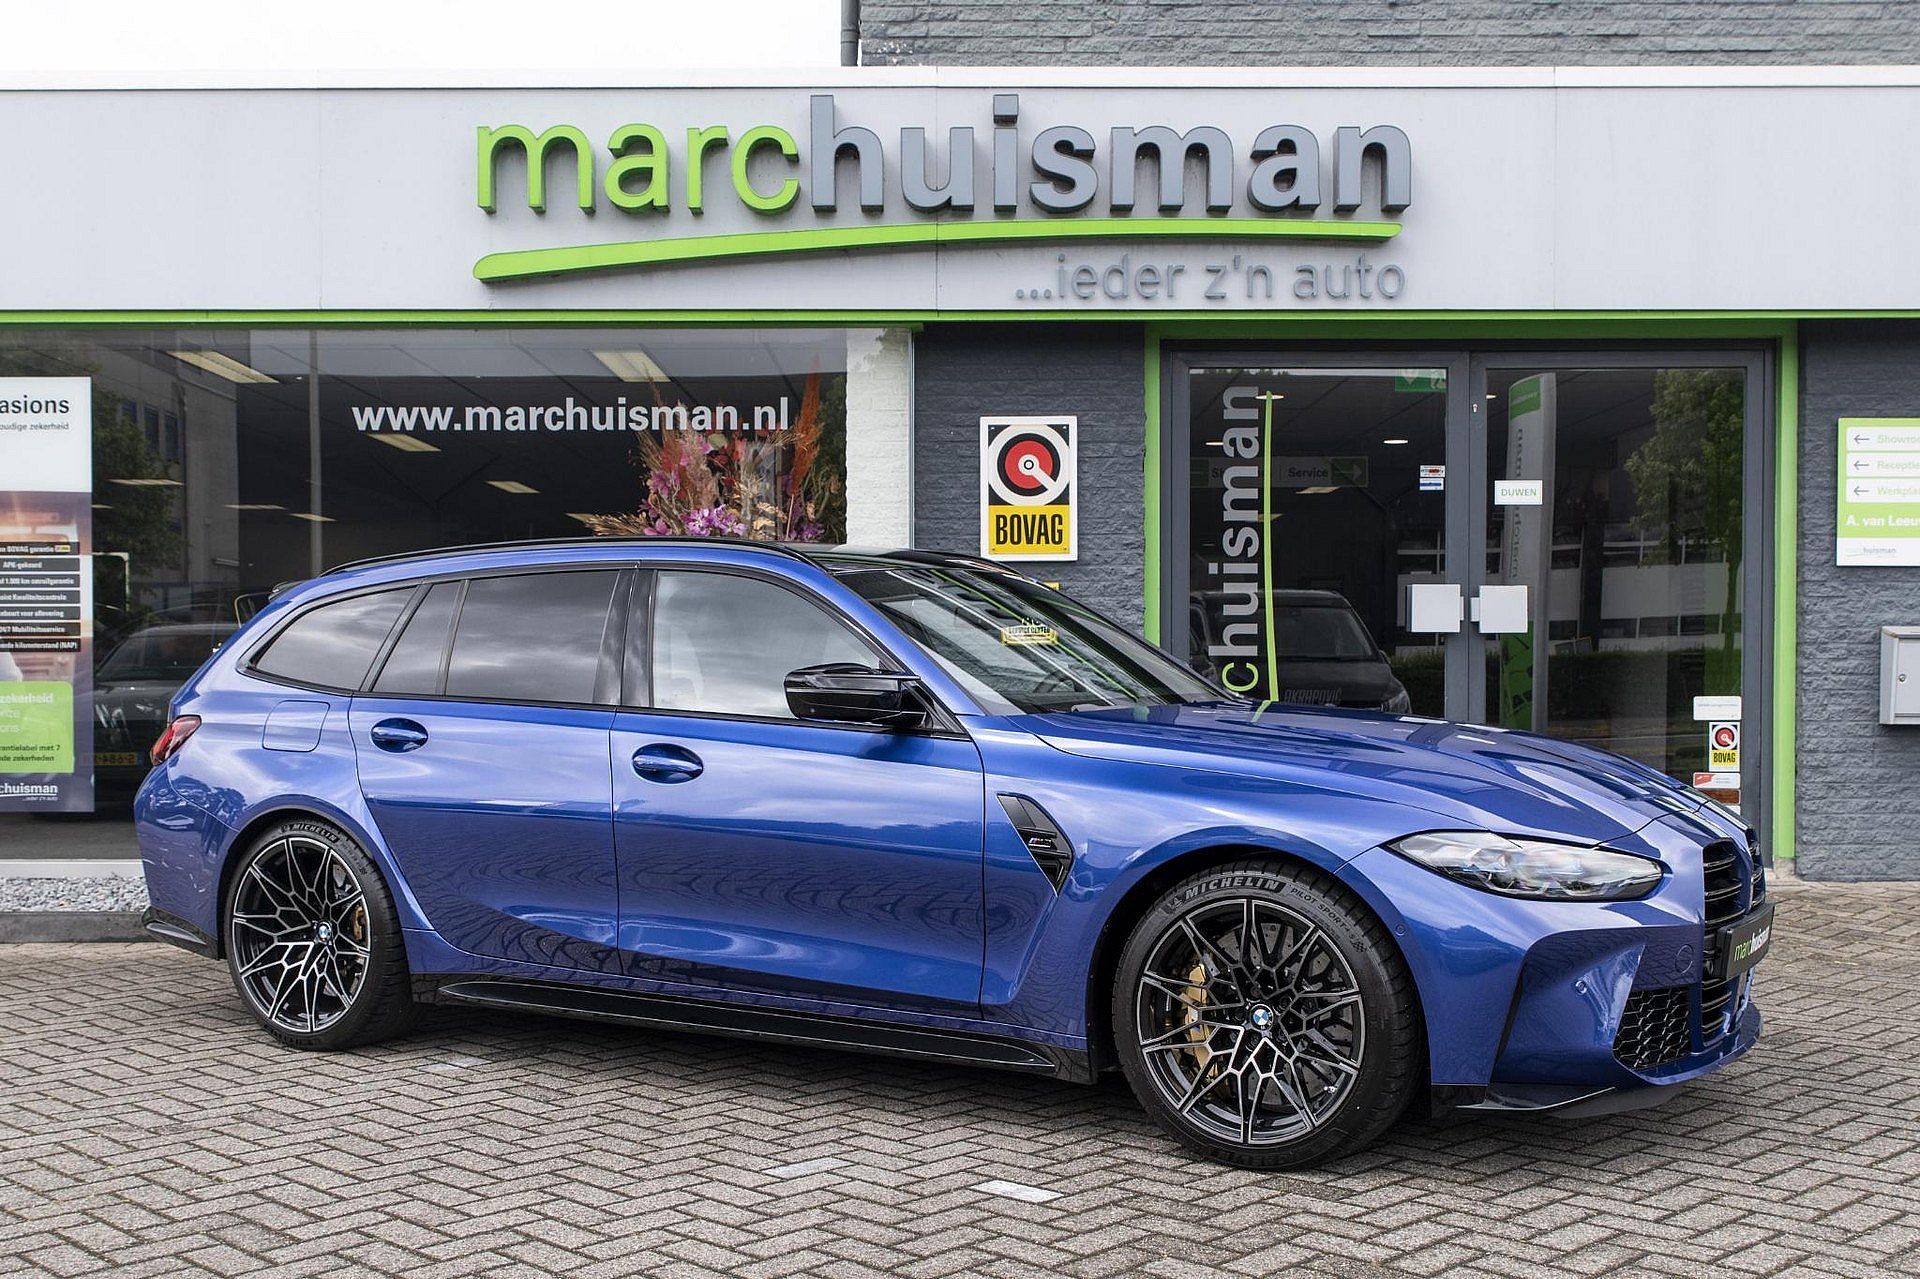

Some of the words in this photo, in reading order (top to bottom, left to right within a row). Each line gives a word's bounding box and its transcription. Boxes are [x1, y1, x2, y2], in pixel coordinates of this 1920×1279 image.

[477, 94, 1412, 215] marchuisman
[1204, 254, 1273, 299] z'n
[1293, 253, 1406, 299] auto
[0, 394, 70, 414] asions
[352, 397, 788, 431] www.marchuisman.nl
[1287, 466, 1329, 479] Service
[1500, 488, 1537, 497] DUWEN
[994, 513, 1063, 545] BOVAG
[1862, 517, 1885, 527] van
[1887, 514, 1920, 527] Leeu
[1713, 752, 1736, 763] BOVAG
[292, 823, 338, 842] MICHELIN
[1185, 876, 1280, 900] MICHELIN
[1290, 887, 1318, 904] PILOT
[1317, 904, 1348, 928] SPORT
